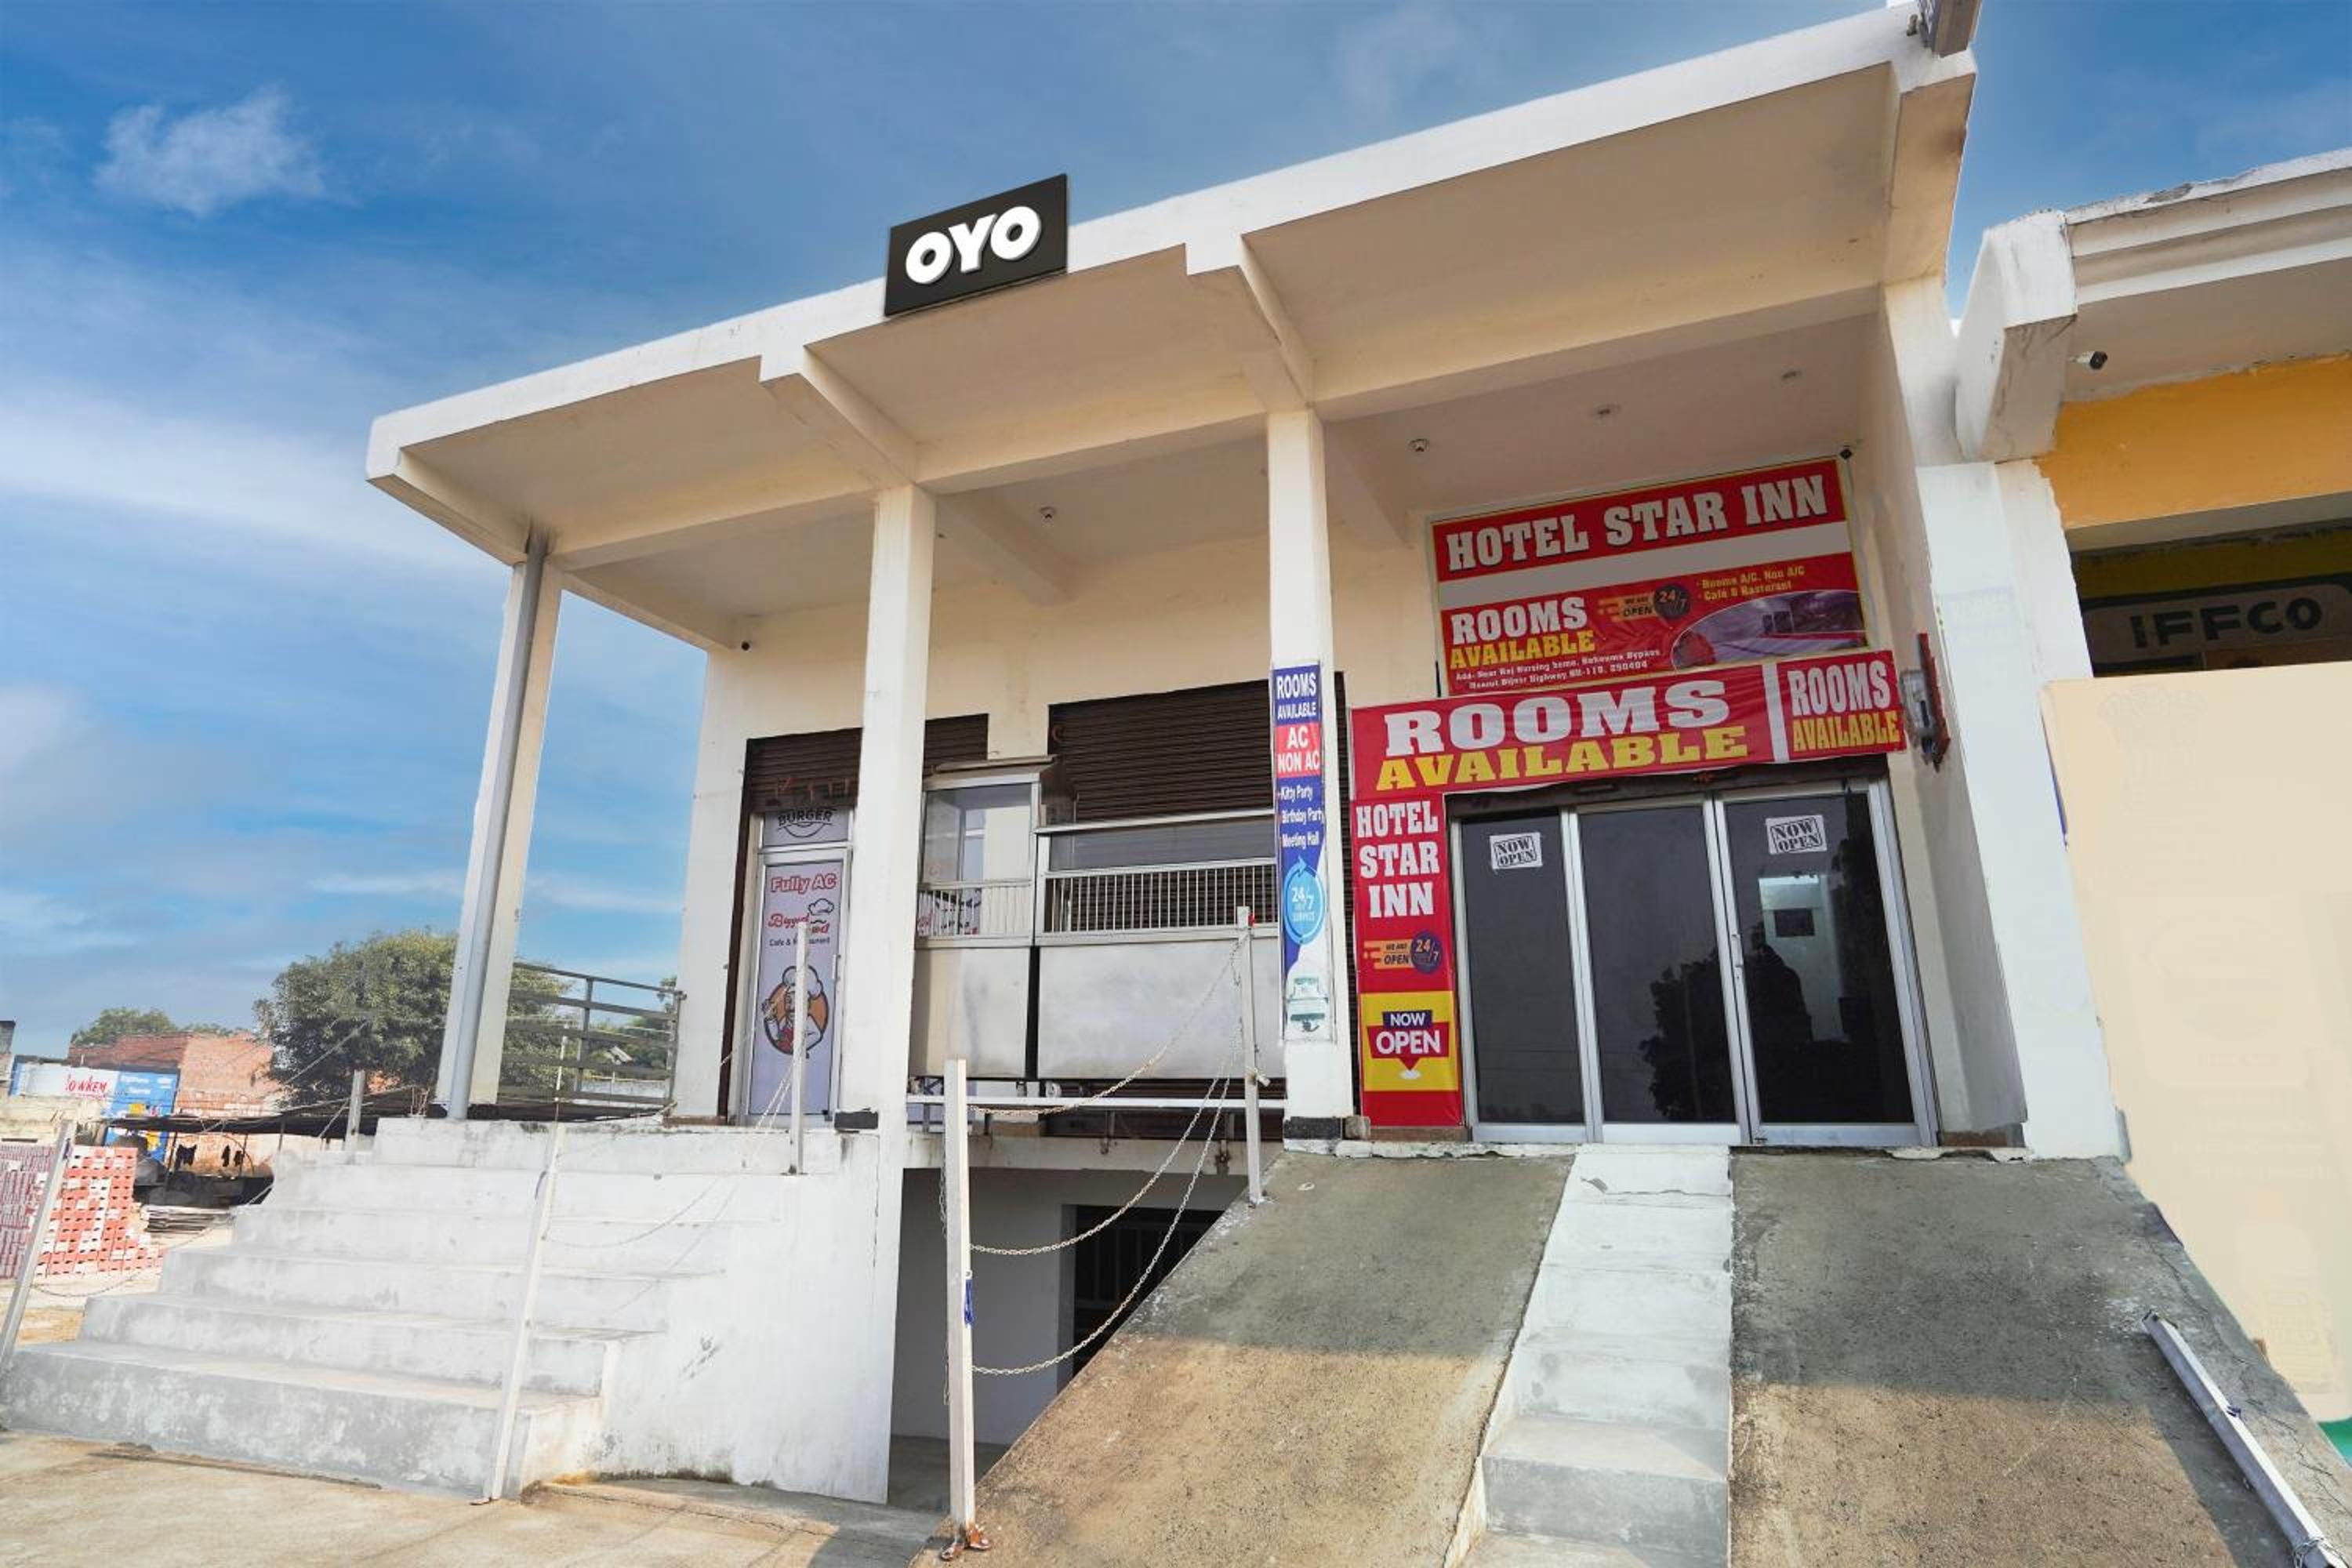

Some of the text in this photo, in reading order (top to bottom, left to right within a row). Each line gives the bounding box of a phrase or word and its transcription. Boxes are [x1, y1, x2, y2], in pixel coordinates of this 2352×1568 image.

[906, 206, 1042, 285] OYO
[1446, 475, 1828, 572] HOTEL STAR INN
[1451, 597, 1588, 645] ROOMS
[1624, 606, 1653, 617] OPEN
[2129, 597, 2323, 648] IFFCO
[1450, 630, 1595, 670] AVAILABLE
[1276, 673, 1316, 700] ROOMS
[1277, 702, 1316, 720] AVAILABLE
[1385, 661, 1892, 757] ROOMS ROOMS
[1287, 726, 1309, 749] AC
[1277, 750, 1320, 773] NON AC
[1376, 711, 1900, 792] AVAILABLE AVAILABLE
[1297, 785, 1313, 801] Party
[777, 808, 833, 826] BURGER
[1356, 800, 1439, 838] HOTEL
[1773, 820, 1813, 840] NOW
[1497, 837, 1530, 855] NOW
[1778, 833, 1820, 851] OPEN
[1359, 840, 1440, 879] STAR
[1500, 850, 1534, 865] OPEN
[771, 873, 837, 895] Fully AC
[1368, 882, 1434, 918] INN
[1384, 953, 1410, 965] OPEN
[1390, 1012, 1426, 1026] NOW
[1376, 1030, 1440, 1054] OPEN
